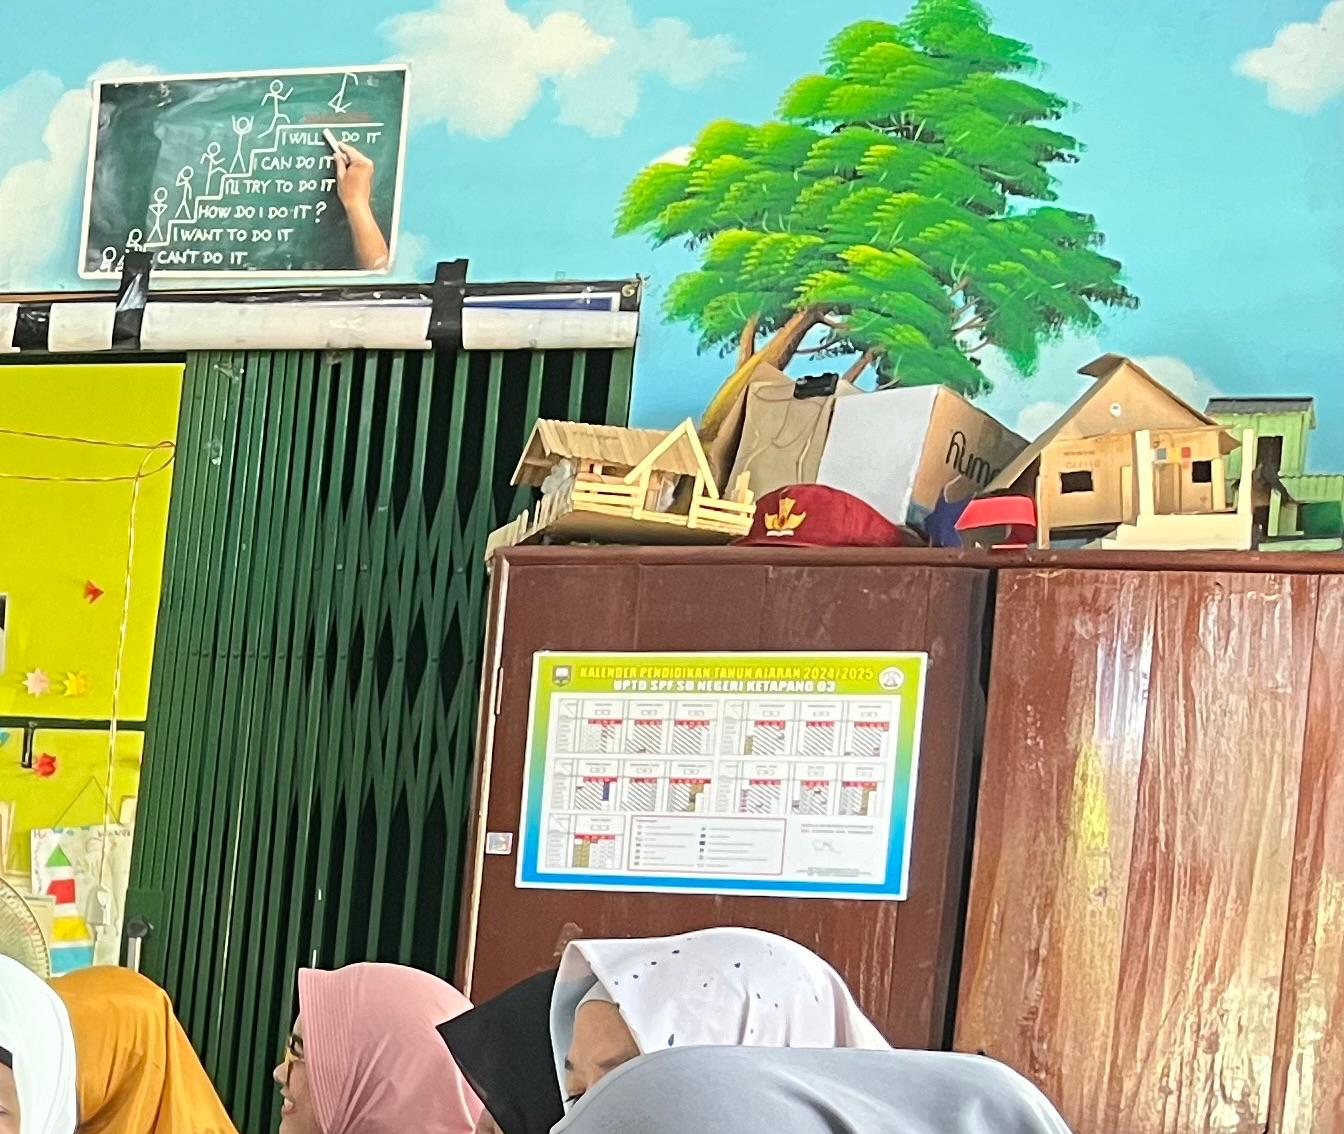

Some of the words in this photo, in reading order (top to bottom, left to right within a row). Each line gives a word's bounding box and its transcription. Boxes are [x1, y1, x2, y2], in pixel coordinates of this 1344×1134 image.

[281, 131, 287, 145] I
[289, 131, 325, 146] WILL
[341, 131, 360, 143] DO
[366, 131, 382, 144] IT
[261, 156, 292, 170] CAN
[295, 156, 316, 170] DO
[318, 156, 336, 170] IT
[244, 179, 272, 194] TRY
[275, 179, 294, 193] TO
[298, 179, 317, 192] DO
[320, 179, 336, 192] IT
[198, 205, 231, 219] HOW
[234, 205, 255, 219] DO
[268, 205, 288, 220] DO
[180, 228, 223, 242] WANT
[227, 228, 247, 242] TO
[251, 229, 272, 242] DO
[278, 228, 295, 242] IT
[157, 250, 200, 265] CAN'T
[203, 251, 223, 265] DO
[230, 251, 248, 265] IT
[579, 666, 637, 680] KALENDER
[639, 666, 711, 680] PENDIDIKAN
[714, 666, 752, 680] TAHUN
[754, 666, 802, 680] AJARAN
[803, 666, 874, 681] 2024/2025
[613, 679, 648, 692] UPTD
[650, 679, 674, 692] SPF
[676, 679, 695, 692] SD
[697, 679, 743, 692] NEGERI
[746, 679, 814, 693] KETAPANG
[816, 680, 837, 693] 03
